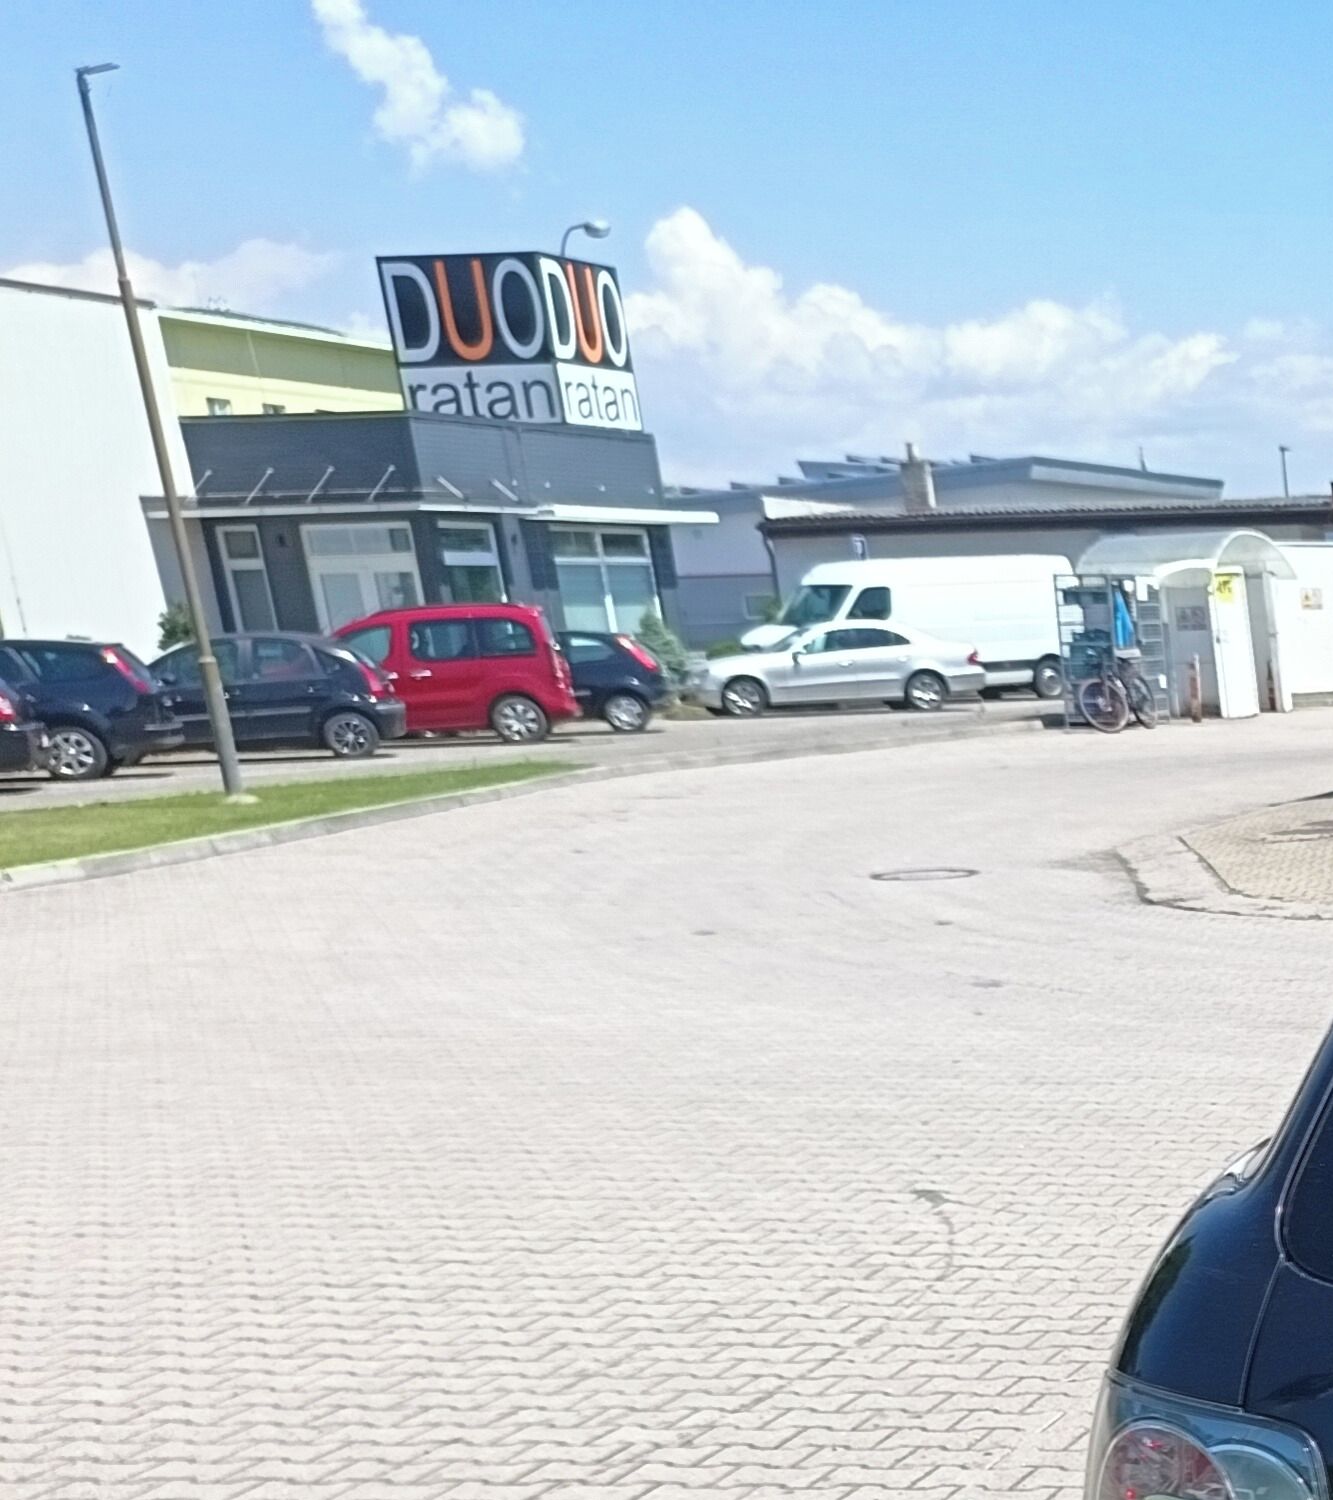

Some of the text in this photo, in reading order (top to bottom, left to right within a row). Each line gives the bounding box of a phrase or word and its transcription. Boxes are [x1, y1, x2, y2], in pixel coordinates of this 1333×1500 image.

[380, 257, 544, 363] DUO
[540, 257, 628, 368] DUO
[407, 370, 556, 420] ratan
[564, 374, 640, 422] ratan
